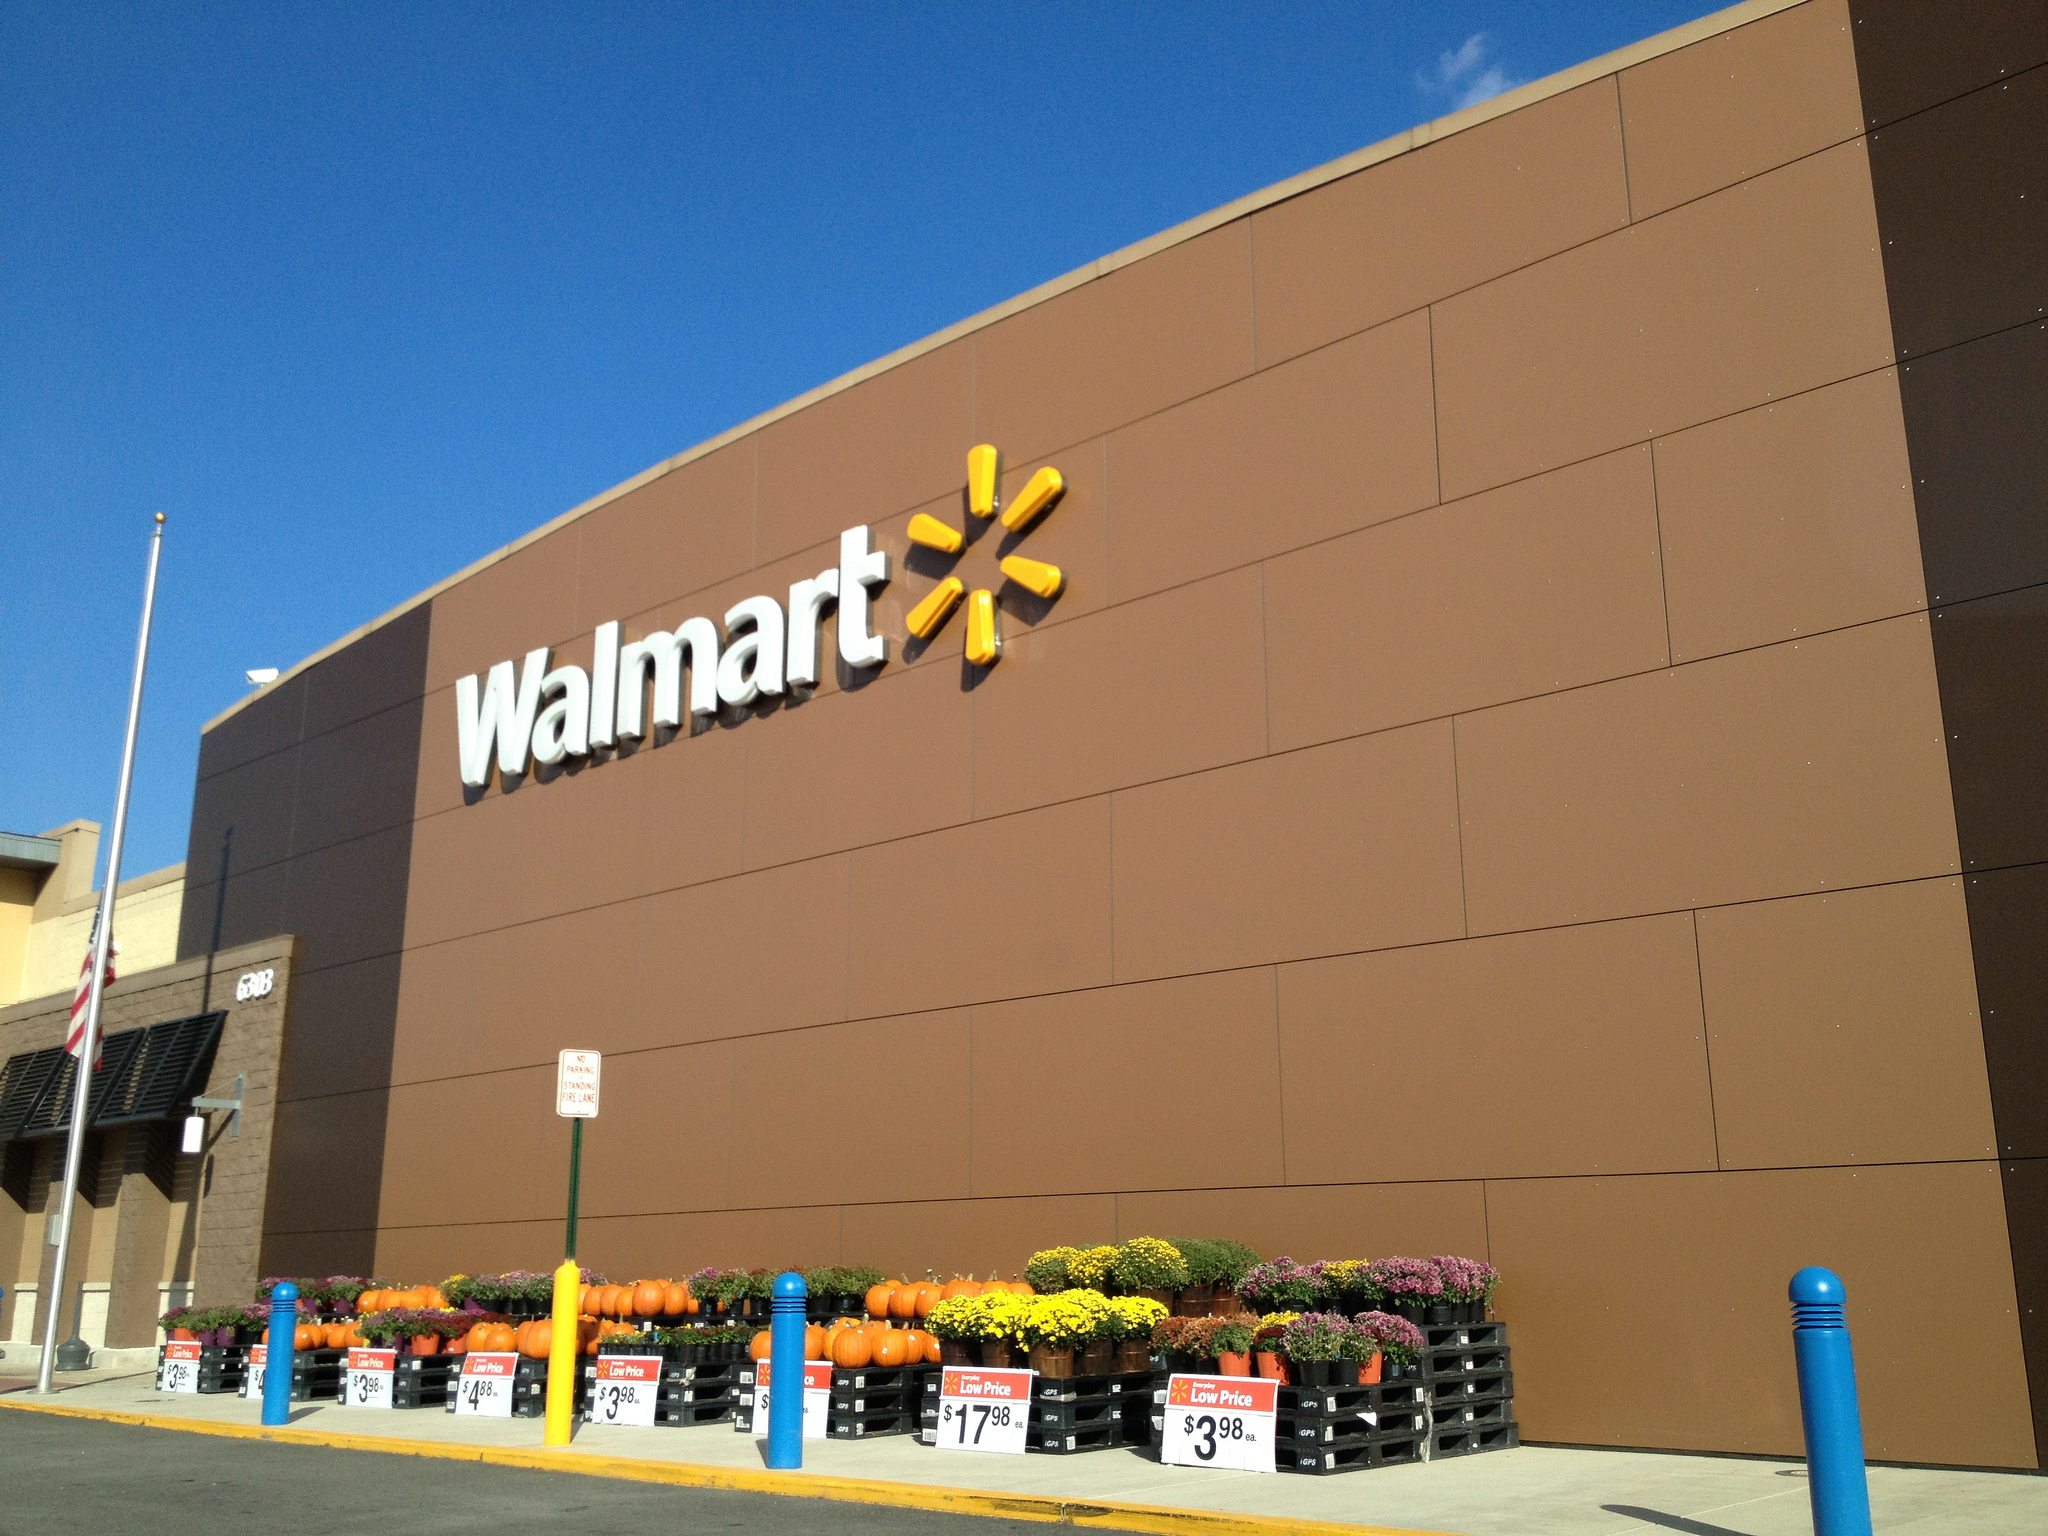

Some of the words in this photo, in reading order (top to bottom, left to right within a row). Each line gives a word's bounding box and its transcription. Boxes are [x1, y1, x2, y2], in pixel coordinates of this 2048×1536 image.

[455, 524, 891, 788] Walmart
[576, 1055, 586, 1063] NO
[566, 1065, 595, 1075] PARKING
[563, 1081, 596, 1091] STANDING
[562, 1092, 577, 1103] FIRE
[578, 1093, 596, 1104] LANE
[486, 1362, 504, 1374] Price
[609, 1365, 626, 1376] Low
[625, 1365, 645, 1377] Price
[961, 1374, 981, 1382] Everyday
[960, 1380, 983, 1394] Low
[983, 1381, 1012, 1396] Price
[1192, 1381, 1216, 1390] Everyday
[1190, 1388, 1218, 1403] Low
[1219, 1389, 1253, 1407] Price
